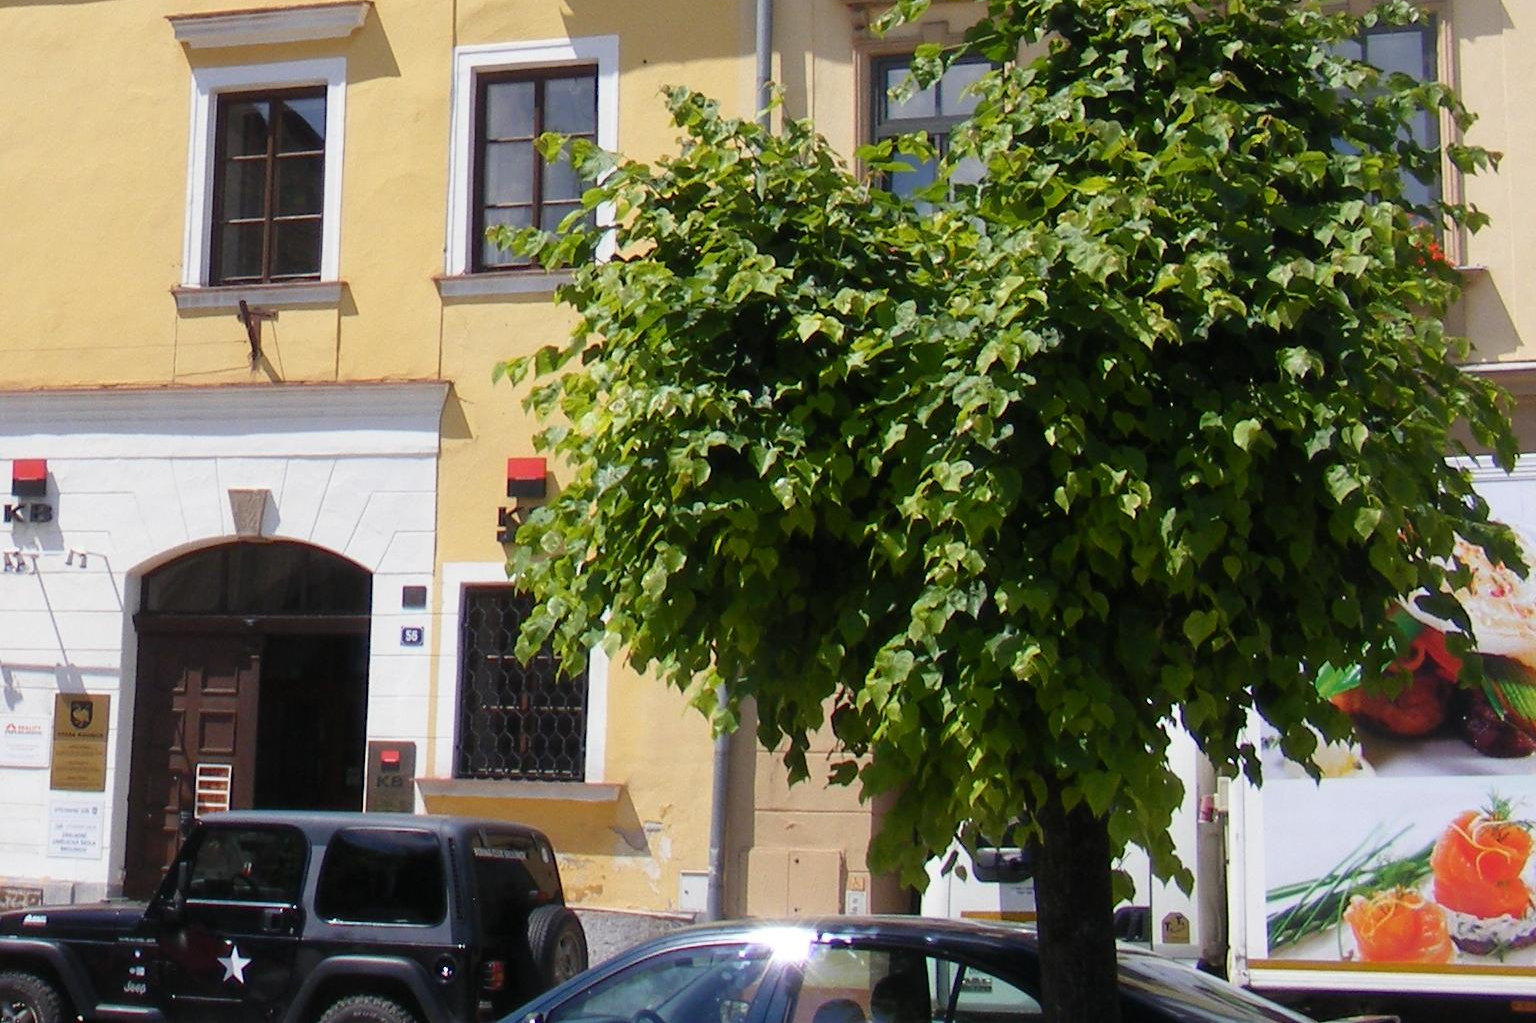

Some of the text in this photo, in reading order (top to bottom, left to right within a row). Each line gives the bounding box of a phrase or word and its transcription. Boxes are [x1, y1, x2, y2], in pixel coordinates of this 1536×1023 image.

[4, 504, 53, 523] KB
[406, 630, 418, 642] 56
[376, 776, 404, 788] KB
[123, 980, 146, 994] Jeep
